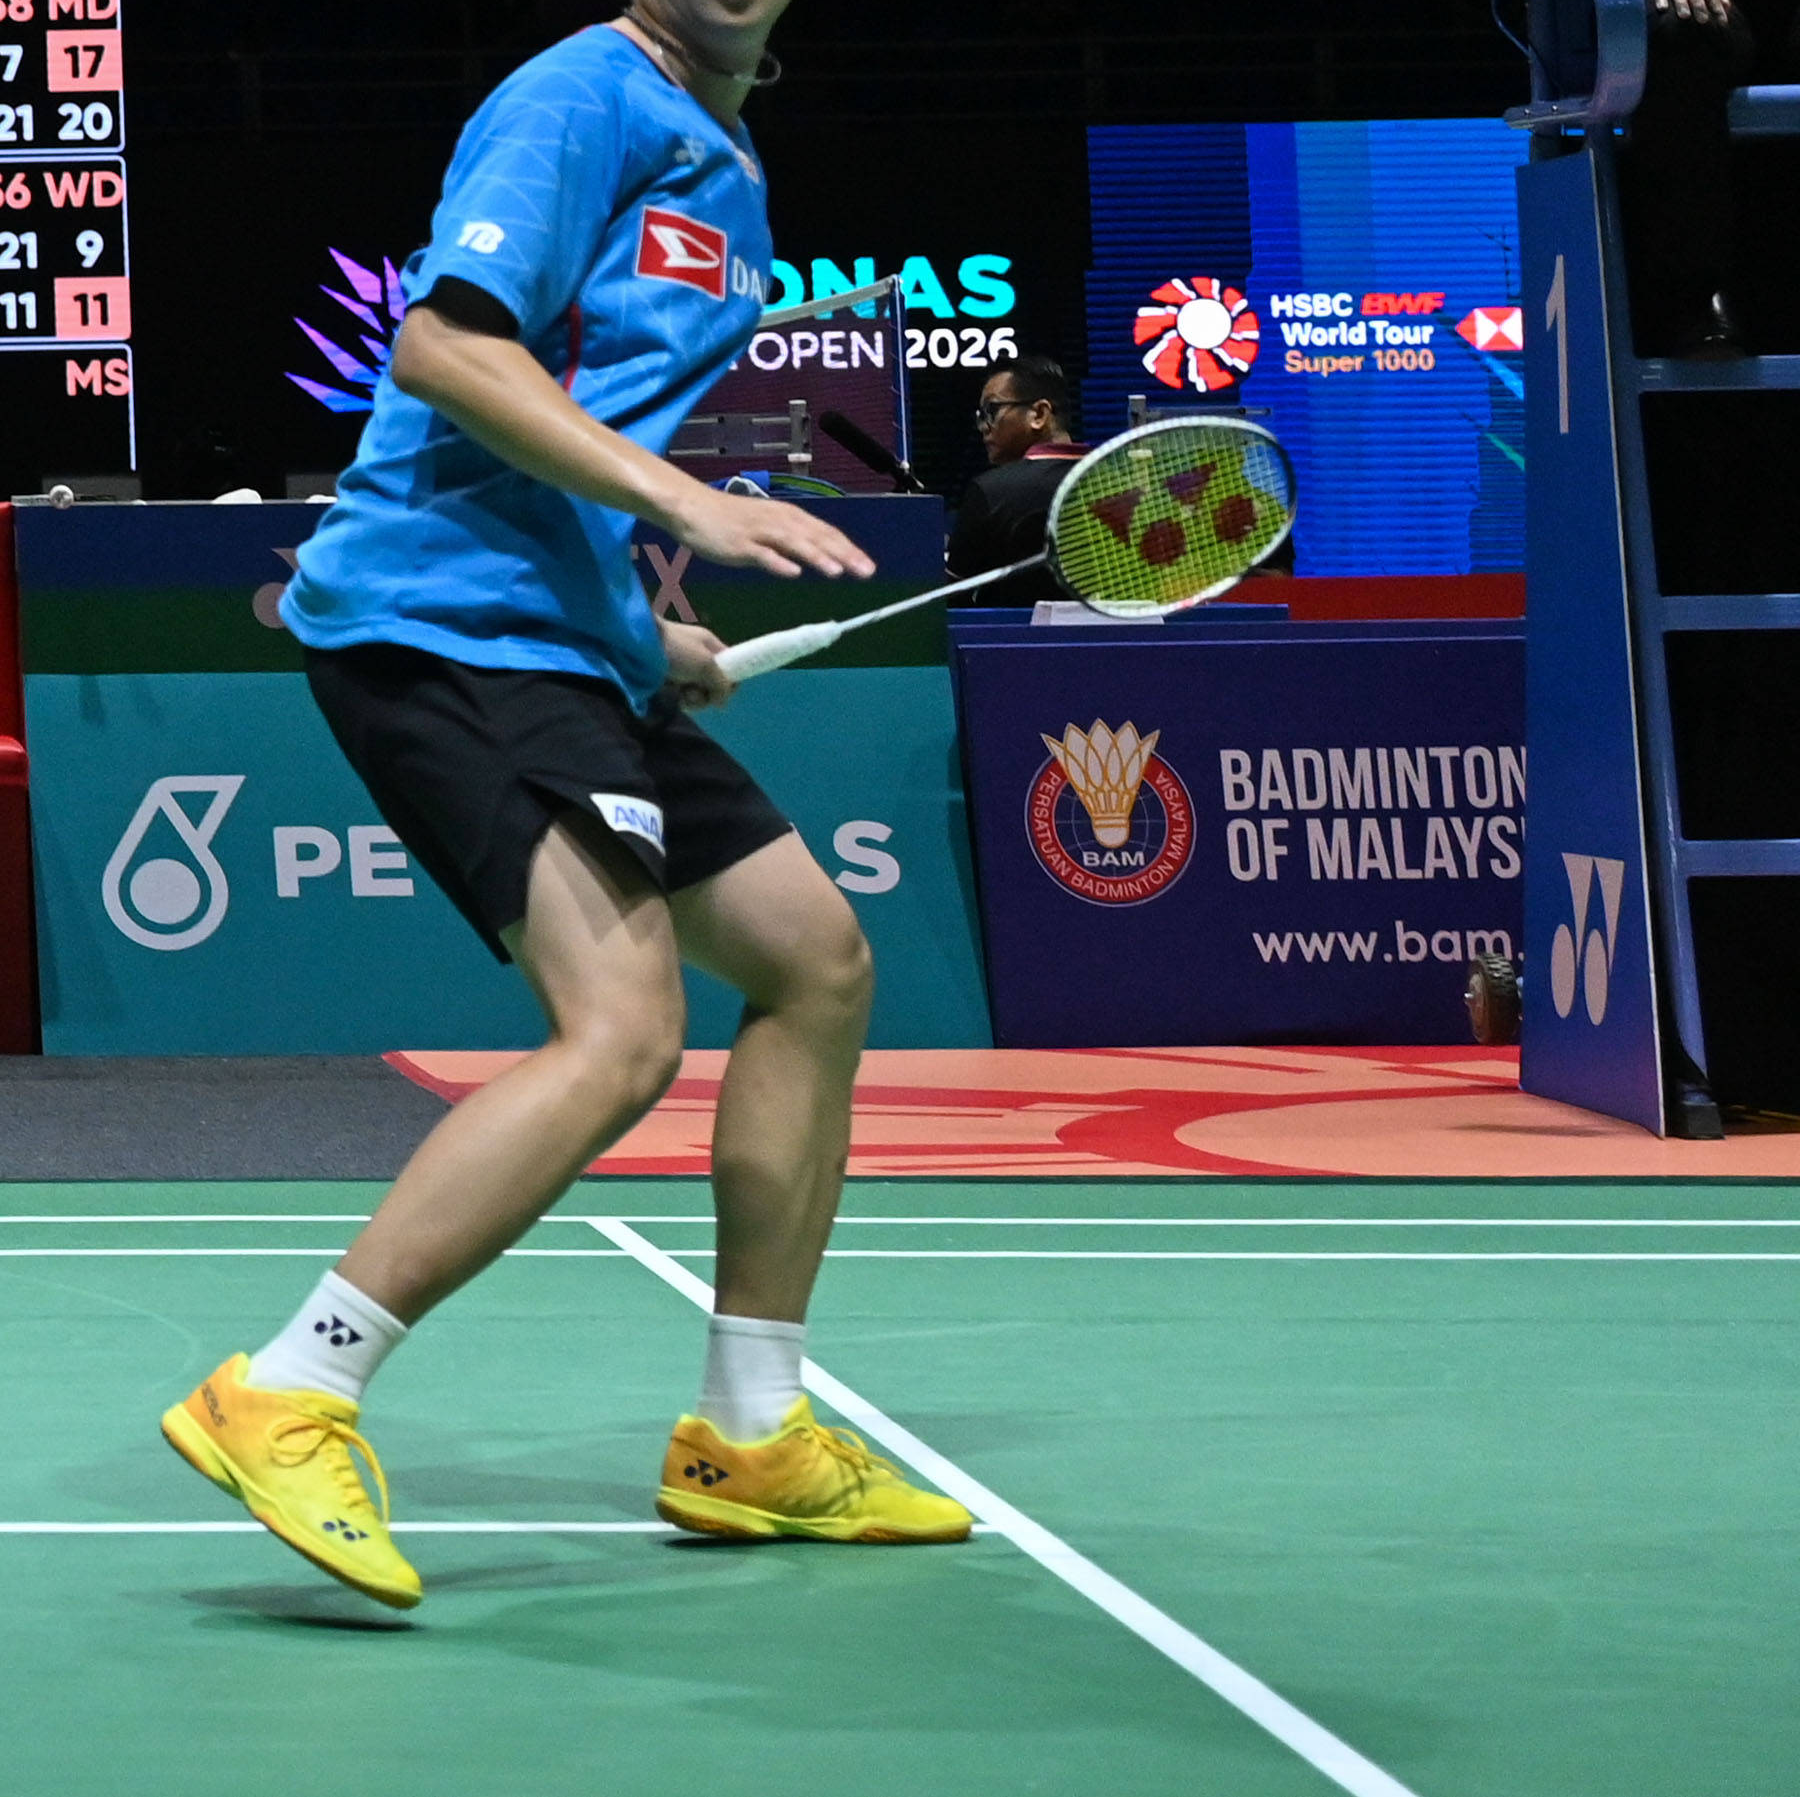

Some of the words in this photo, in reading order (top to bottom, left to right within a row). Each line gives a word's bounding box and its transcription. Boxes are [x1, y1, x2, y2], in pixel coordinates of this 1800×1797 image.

[64, 43, 105, 80] 17
[58, 102, 112, 140] 20
[43, 171, 124, 207] WD
[76, 230, 103, 268] 9
[73, 292, 109, 327] 11
[1270, 292, 1353, 318] HSBC
[1360, 292, 1446, 316] BWF
[749, 330, 884, 371] OPEN
[1280, 321, 1367, 346] World
[1368, 320, 1435, 345] Tour
[1545, 254, 1570, 435] 1
[66, 359, 131, 396] MS
[1284, 349, 1364, 378] Super
[1373, 348, 1435, 372] 1000
[1219, 745, 1527, 811] BADMINTON
[614, 805, 662, 844] ANA
[1032, 771, 1072, 878] PERSATUAN
[1070, 860, 1175, 898] BADMINTON
[1155, 770, 1188, 861] MALAYSIA
[1082, 851, 1145, 867] BAM
[1226, 817, 1290, 881] OF
